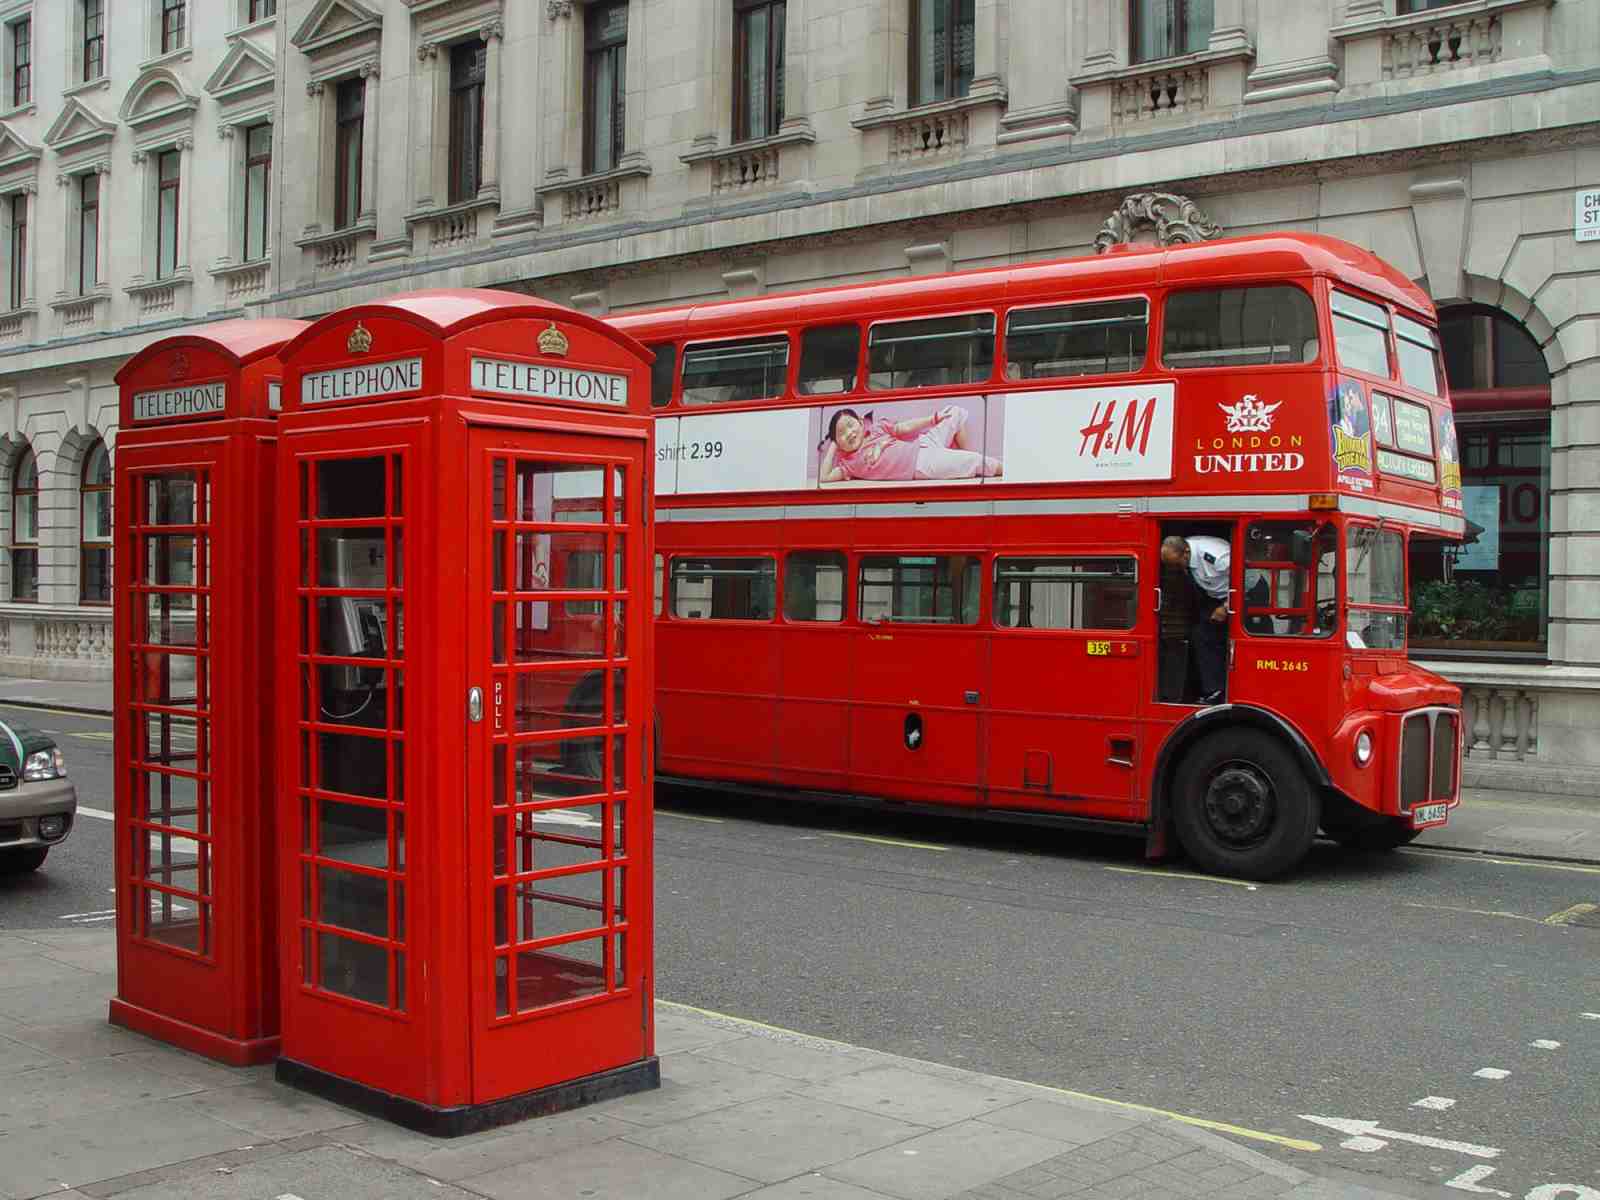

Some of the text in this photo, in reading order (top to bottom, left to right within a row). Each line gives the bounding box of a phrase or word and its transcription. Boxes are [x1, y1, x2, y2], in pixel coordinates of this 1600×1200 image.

[309, 362, 419, 401] TELEPHONE
[476, 362, 623, 402] TELEPHONE
[138, 385, 225, 417] TELEPHONE
[1079, 397, 1157, 458] H&M
[690, 441, 723, 459] 2.99
[1196, 435, 1303, 450] LONDON
[1193, 453, 1305, 474] UNITED
[1256, 660, 1310, 672] RML 2645
